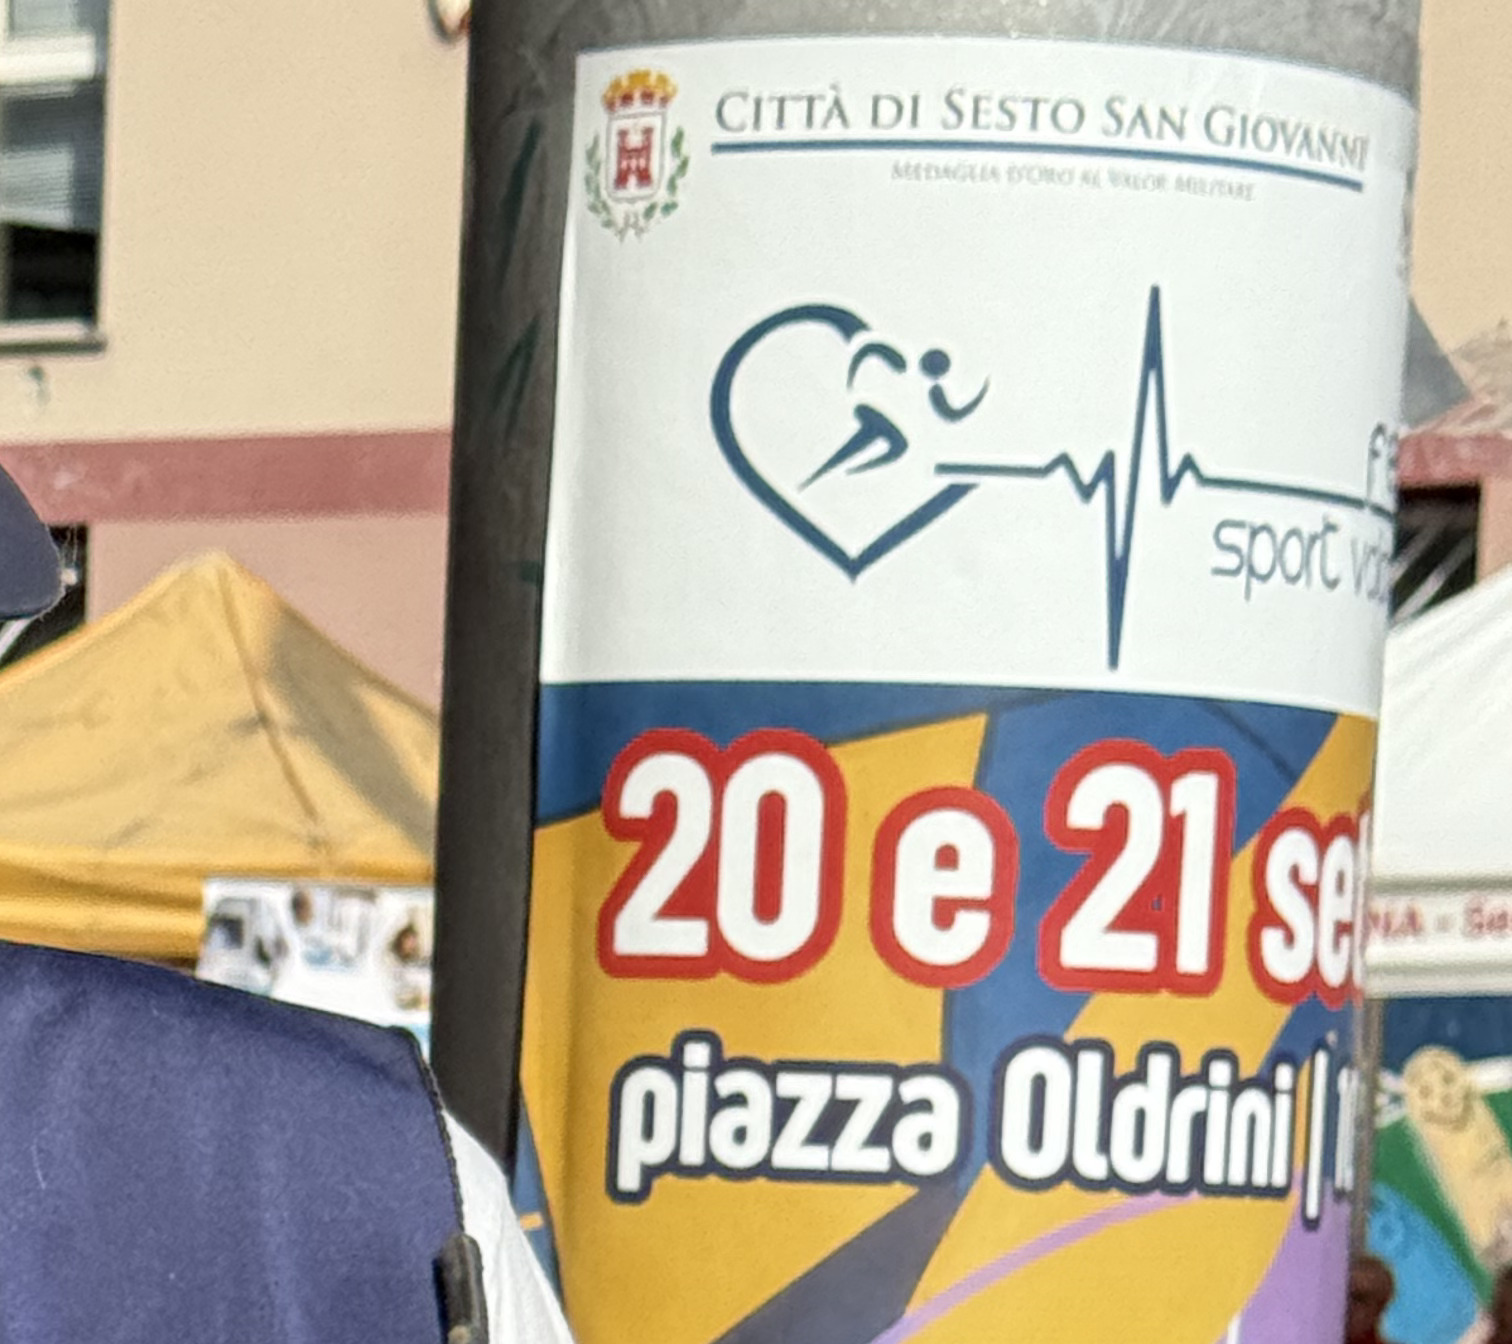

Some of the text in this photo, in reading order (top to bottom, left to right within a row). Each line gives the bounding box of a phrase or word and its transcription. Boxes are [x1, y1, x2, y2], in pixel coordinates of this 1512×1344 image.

[714, 84, 850, 133] CITTÀ
[939, 87, 1087, 135] SESTO
[1100, 95, 1188, 142] SAN
[1203, 104, 1370, 173] GIOVANNI
[1210, 517, 1340, 602] sport
[606, 743, 832, 970] 20
[884, 799, 1006, 976] e
[1051, 754, 1227, 984] 21
[614, 1039, 963, 1193] piazza
[997, 1044, 1295, 1190] Oldrini
